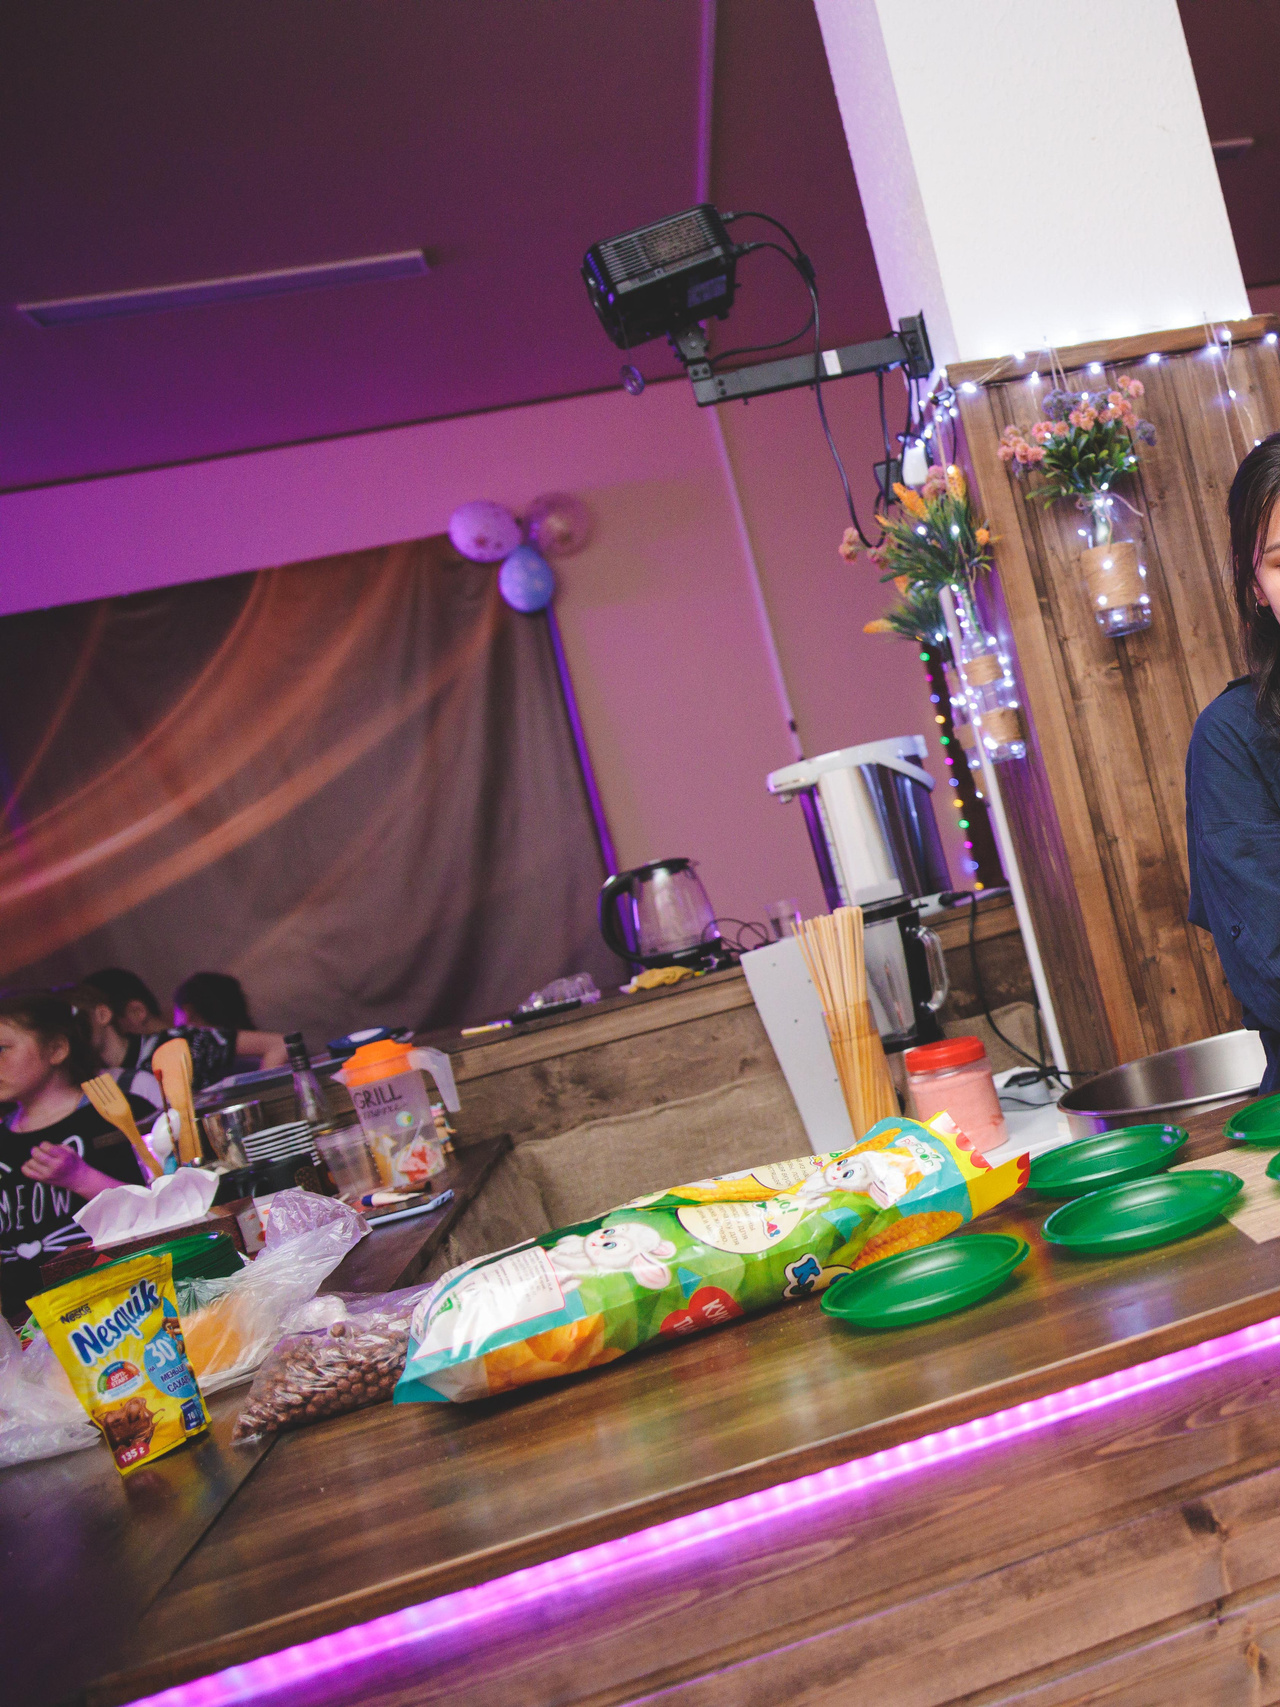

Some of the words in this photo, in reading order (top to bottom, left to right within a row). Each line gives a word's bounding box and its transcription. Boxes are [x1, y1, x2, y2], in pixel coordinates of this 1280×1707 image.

[353, 1083, 402, 1109] GRILL
[0, 1181, 71, 1234] MEOW
[70, 1279, 160, 1365] Nesquik
[144, 1336, 176, 1368] 30
[111, 1375, 129, 1388] START
[166, 1375, 190, 1393] САХАР
[121, 1448, 138, 1462] 135
